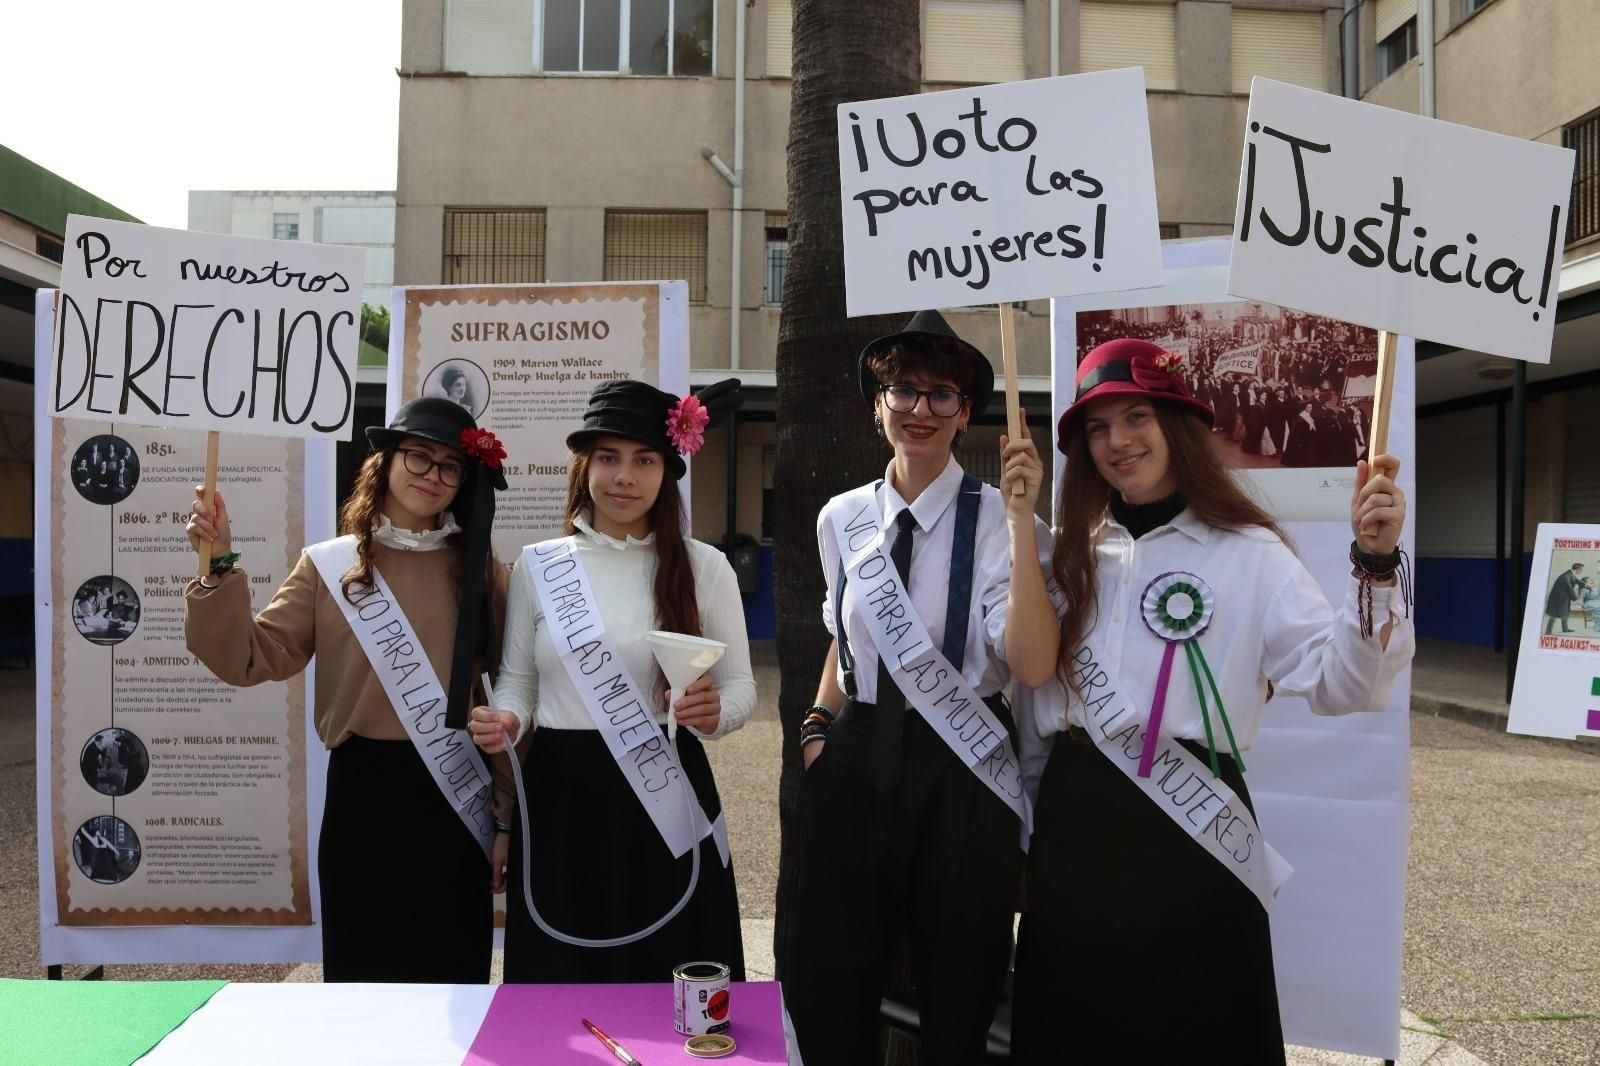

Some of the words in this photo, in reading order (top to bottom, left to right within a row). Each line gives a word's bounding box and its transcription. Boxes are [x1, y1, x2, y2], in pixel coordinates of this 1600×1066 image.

[853, 181, 989, 236] para
[1240, 121, 1561, 322] ¡Justicia!
[908, 203, 1107, 290] mujeres!
[77, 232, 147, 279] Por
[180, 258, 350, 293] nuestros
[451, 320, 610, 343] SUFRAGISMO
[56, 293, 354, 433] DERECHOS
[521, 358, 558, 368] Marion
[561, 358, 603, 367] Wallace
[1215, 360, 1254, 372] JUSTICE
[536, 371, 571, 381] Huelga
[574, 370, 586, 380] de
[146, 441, 176, 456] 1851.
[528, 464, 568, 475] Pausa
[119, 513, 150, 524] 1866.
[155, 513, 167, 524] 2ª
[1554, 538, 1592, 549] TORTURING
[144, 575, 167, 585] 1903.
[252, 574, 271, 584] and
[144, 588, 183, 597] Political
[550, 580, 590, 631] PARA
[567, 624, 612, 676] LAS
[1539, 635, 1558, 649] VOTE
[1559, 639, 1590, 650] AGAINST
[142, 656, 190, 666] ADMITIDO
[866, 578, 913, 646] PARA
[897, 640, 948, 694] LAS
[933, 686, 1025, 800] MUJERES
[1071, 646, 1116, 717] PARA
[372, 619, 421, 687] PARA
[402, 682, 449, 735] LAS
[426, 730, 494, 837] MUJERES
[184, 736, 223, 745] HUELGAS
[226, 736, 238, 745] DE
[240, 736, 280, 745] HAMBRE.
[146, 818, 168, 827] 1908.
[171, 817, 224, 826] RADICALES.
